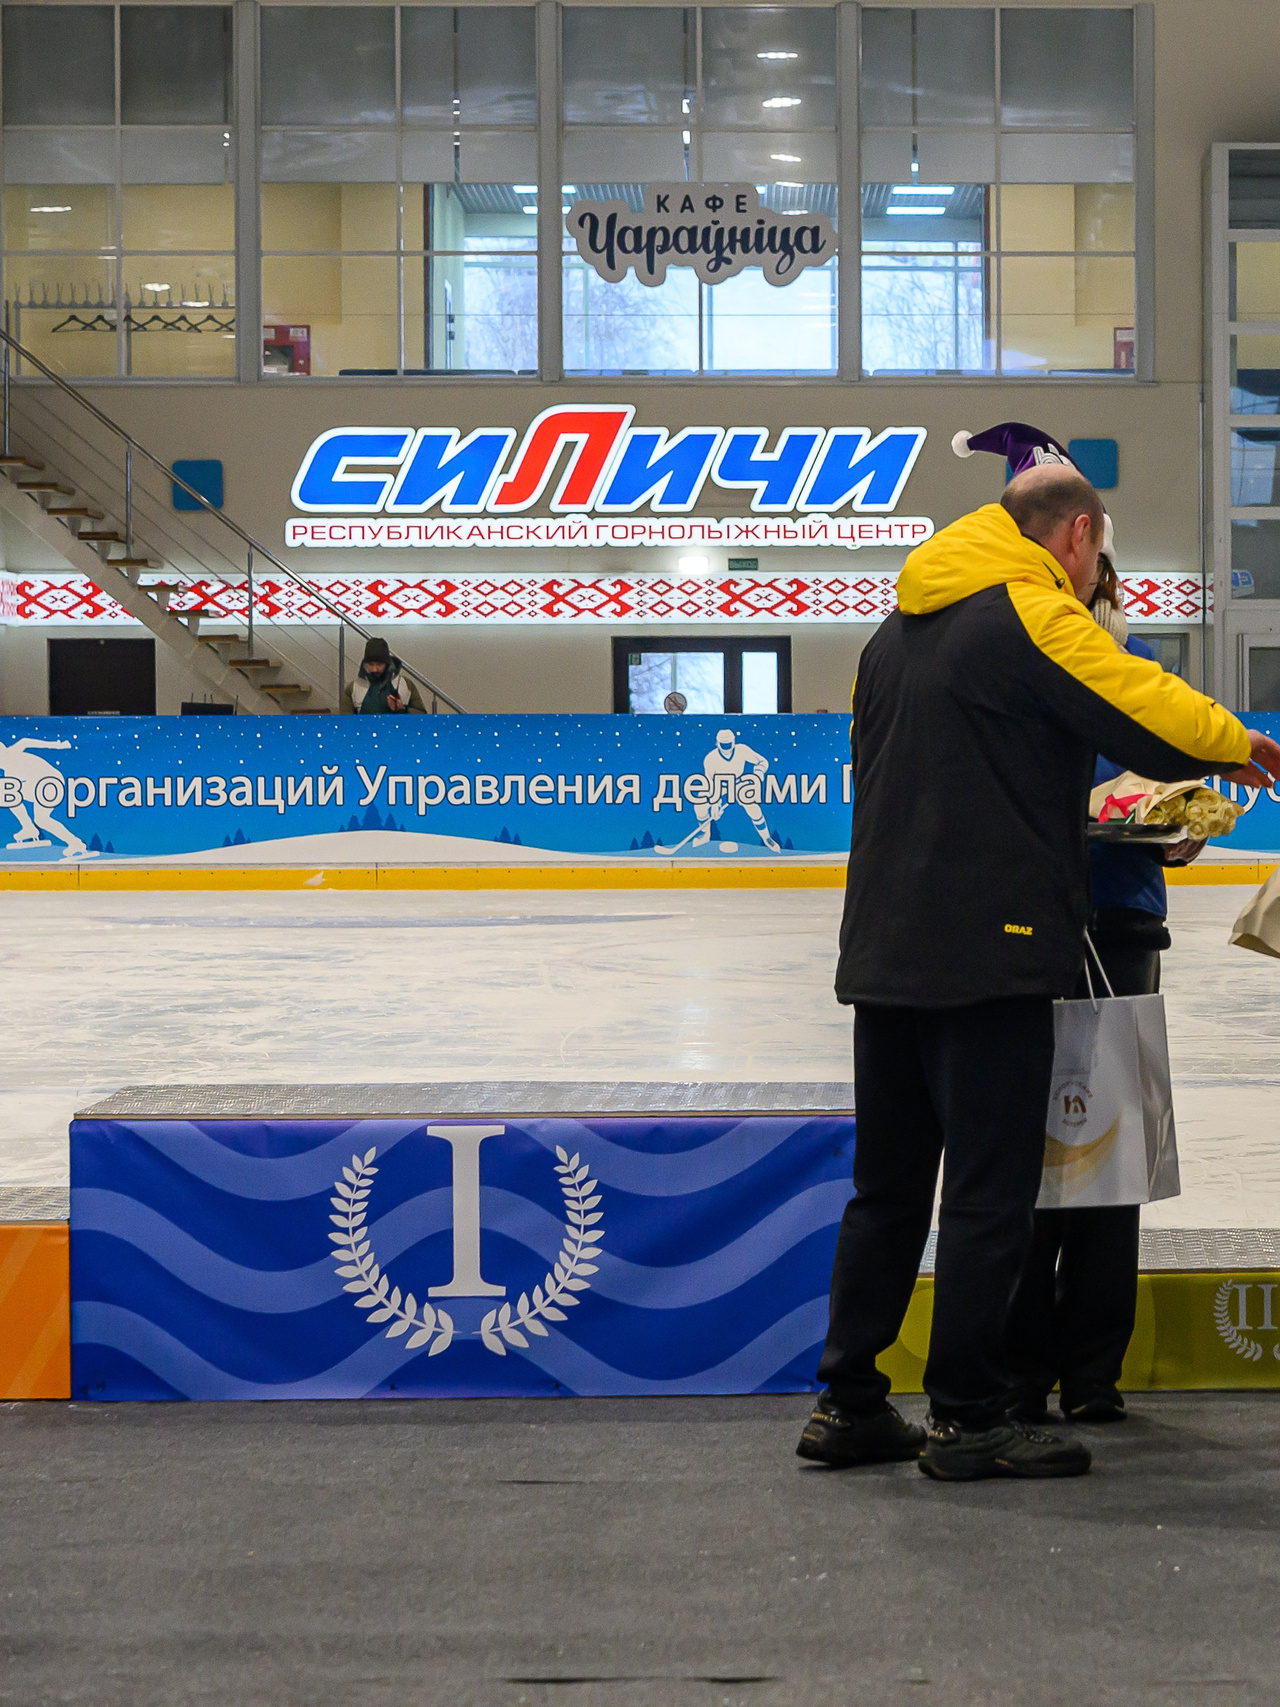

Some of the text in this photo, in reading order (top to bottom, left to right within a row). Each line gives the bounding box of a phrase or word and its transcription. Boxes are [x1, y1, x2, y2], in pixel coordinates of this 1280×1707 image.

[656, 194, 747, 214] КАФЕ
[578, 211, 827, 275] Чараўніца
[291, 520, 927, 543] РЕСПУБЛИКАНСКИЙ ГОРНОЛЫЖНЫЙ ЦЕНТР
[35, 765, 344, 818] организаций
[356, 765, 640, 816] Управления
[652, 773, 828, 812] делами
[427, 1125, 506, 1297] I
